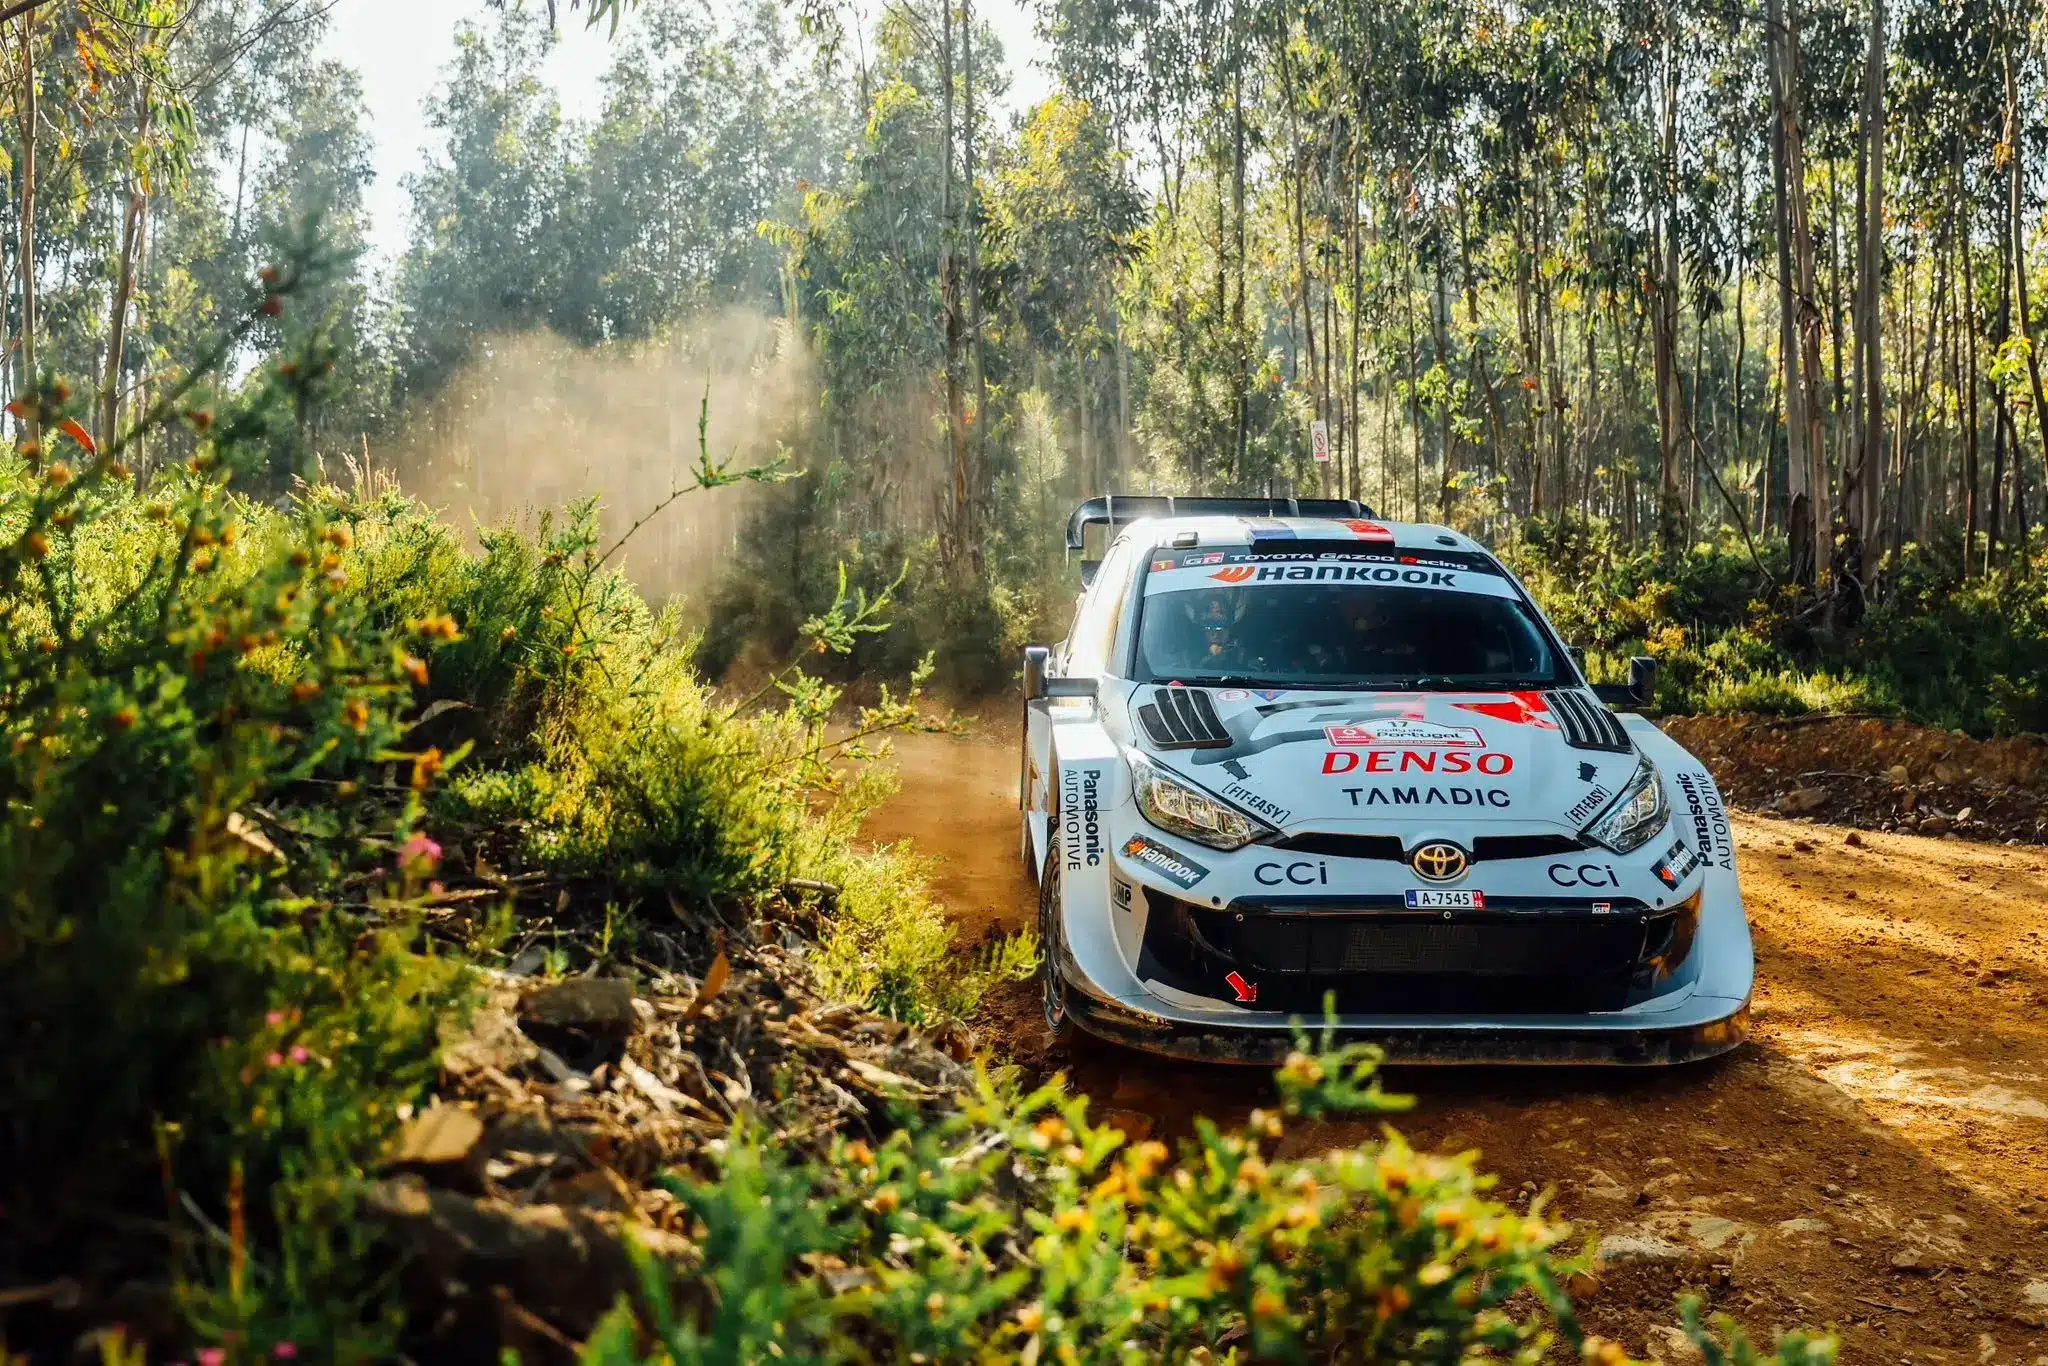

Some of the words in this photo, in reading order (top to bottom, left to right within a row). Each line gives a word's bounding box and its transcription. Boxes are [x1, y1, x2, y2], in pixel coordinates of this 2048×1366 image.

[1230, 553, 1315, 562] TOYOTA
[1319, 553, 1394, 562] GAZOO
[1400, 555, 1468, 571] Racing
[1256, 566, 1456, 587] HANKOOK
[1377, 731, 1463, 739] Portugal
[1387, 720, 1409, 728] 17
[1321, 751, 1514, 775] DENSO
[1341, 786, 1511, 808] TAMADIC
[1064, 769, 1081, 871] AUTOMOTIVE
[1083, 769, 1104, 867] Panasonic
[1676, 772, 1714, 867] Panasonic
[1692, 772, 1732, 871] AUTOMOTIVE
[1136, 845, 1201, 884] HANKOOK
[1254, 861, 1328, 886] CCi
[1547, 863, 1620, 888] CCi
[1422, 892, 1470, 905] A-7545
